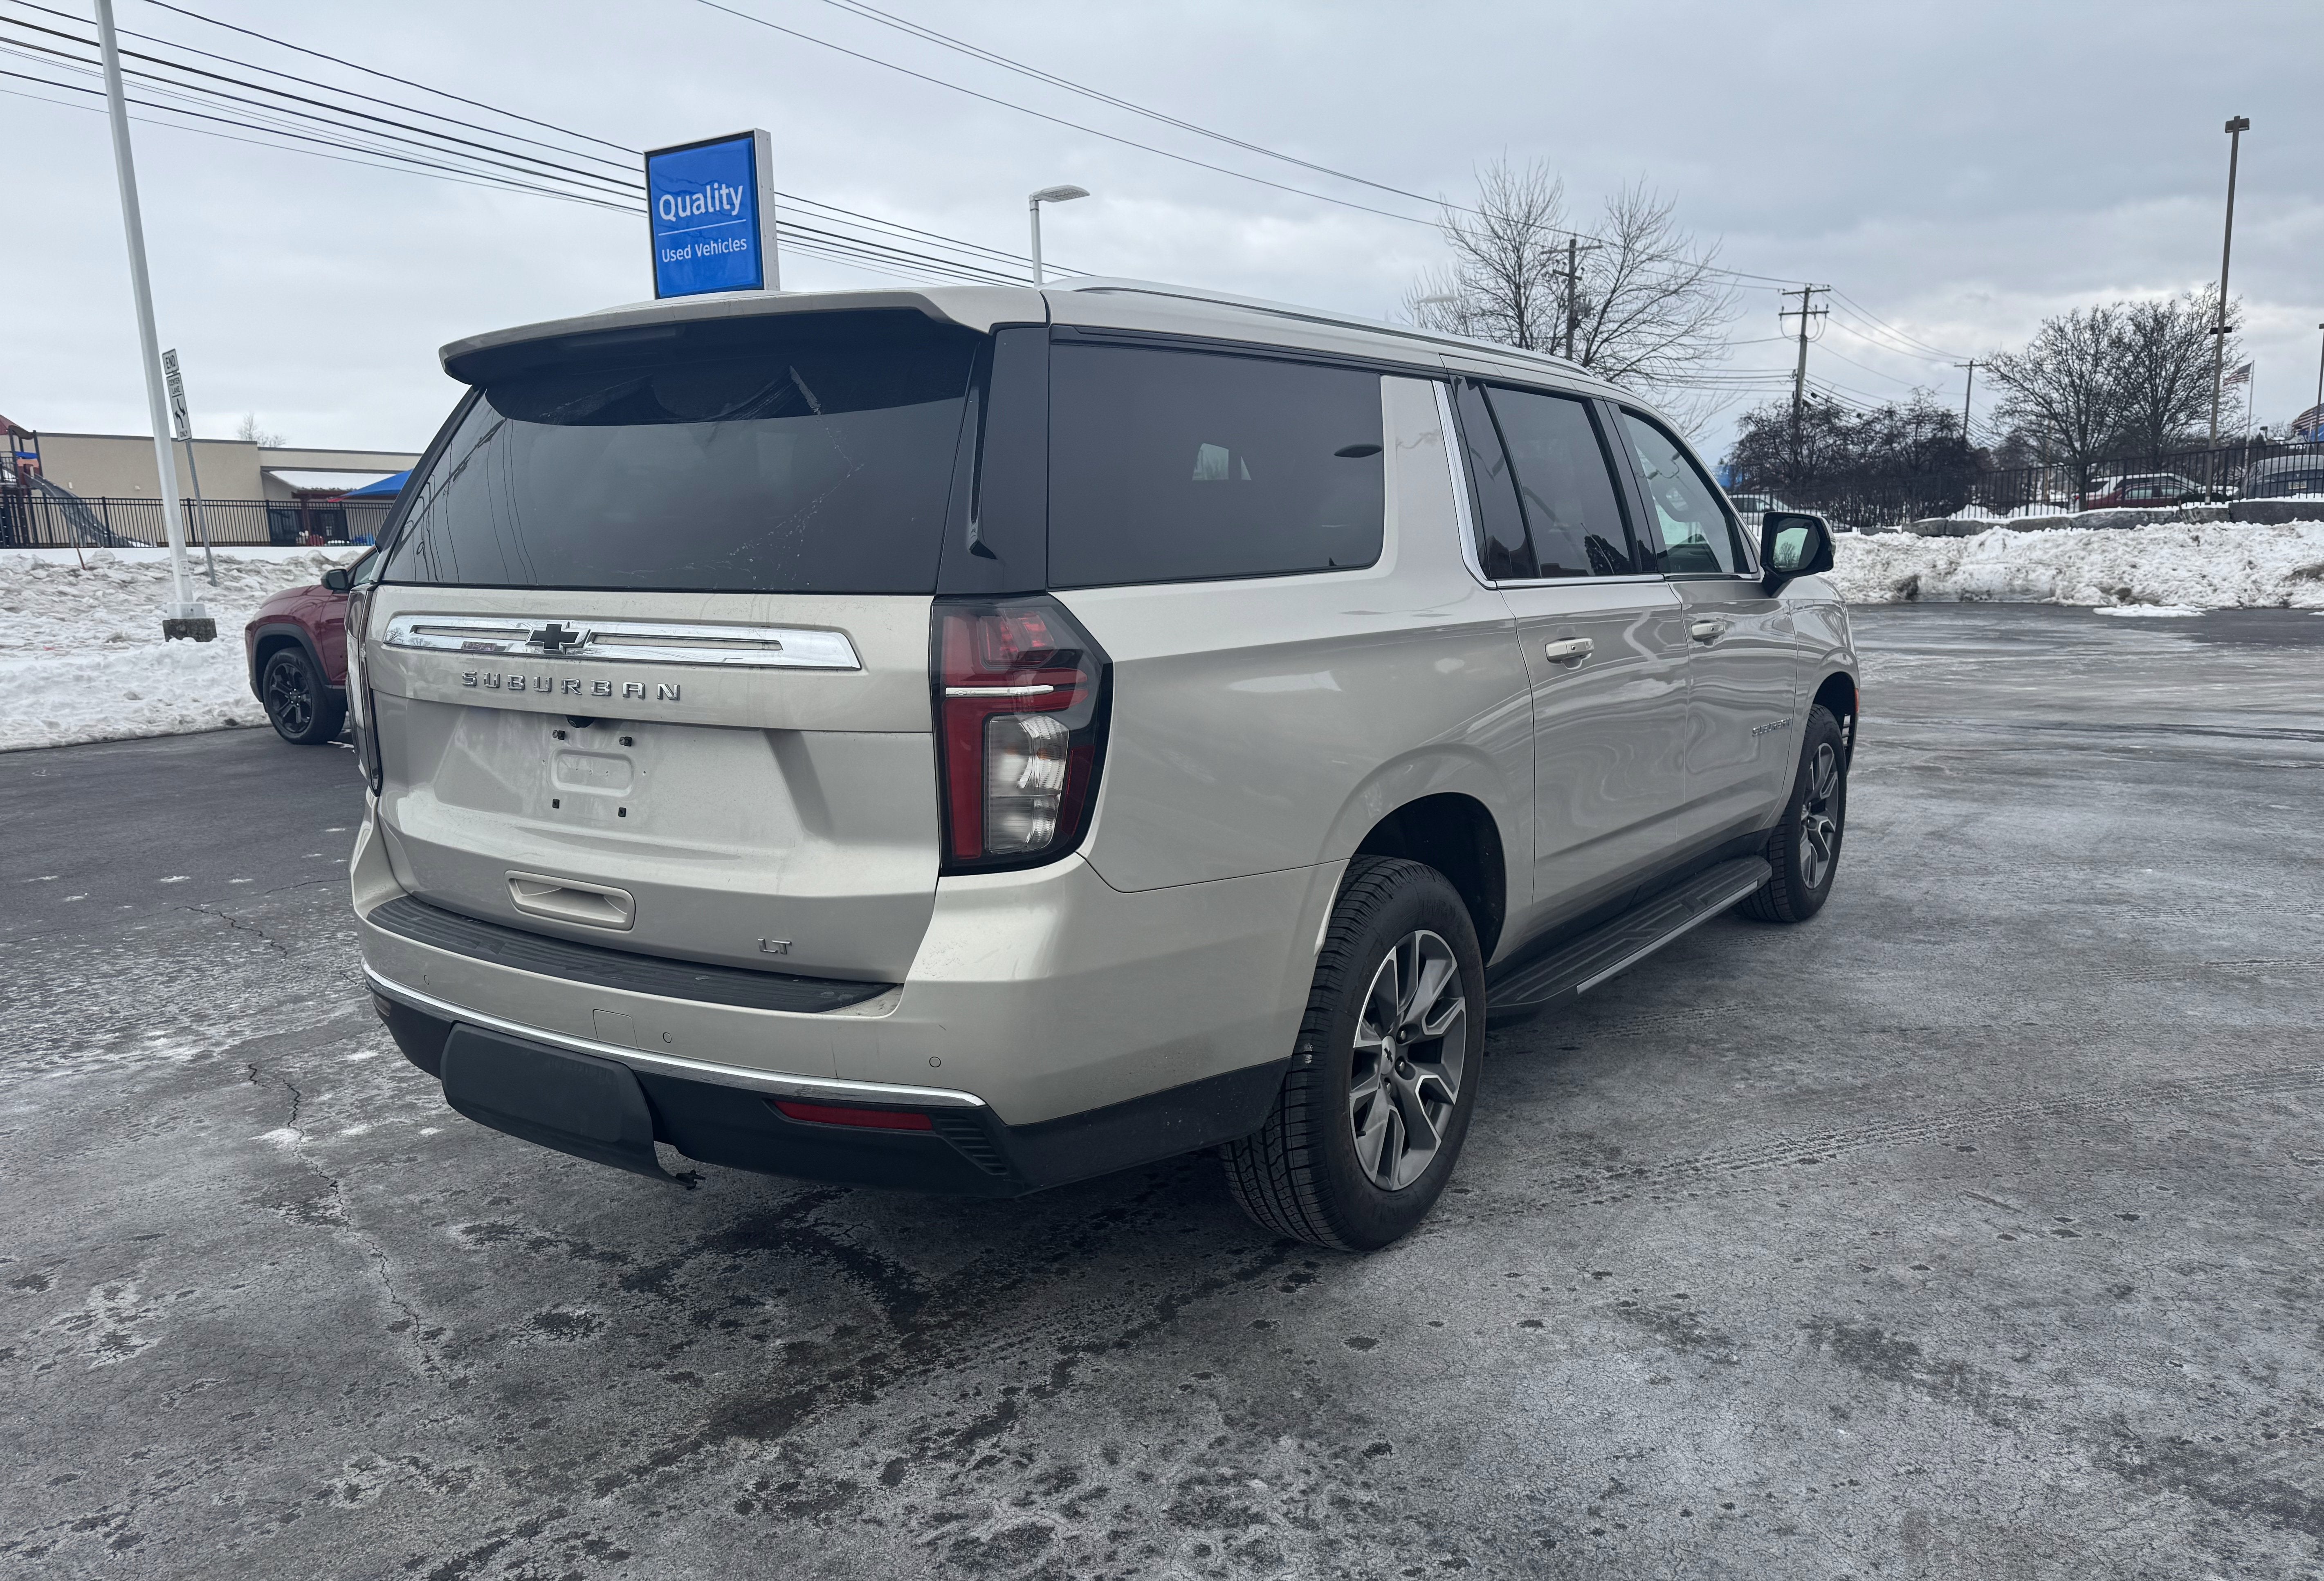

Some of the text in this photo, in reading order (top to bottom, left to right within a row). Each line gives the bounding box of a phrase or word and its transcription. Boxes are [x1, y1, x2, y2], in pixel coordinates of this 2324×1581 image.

[659, 182, 743, 222] Quality
[662, 238, 747, 262] Used Vehicles
[166, 355, 175, 369] END
[172, 386, 180, 394] LANE
[462, 671, 680, 701] SUBURBAN
[757, 938, 792, 955] LT
